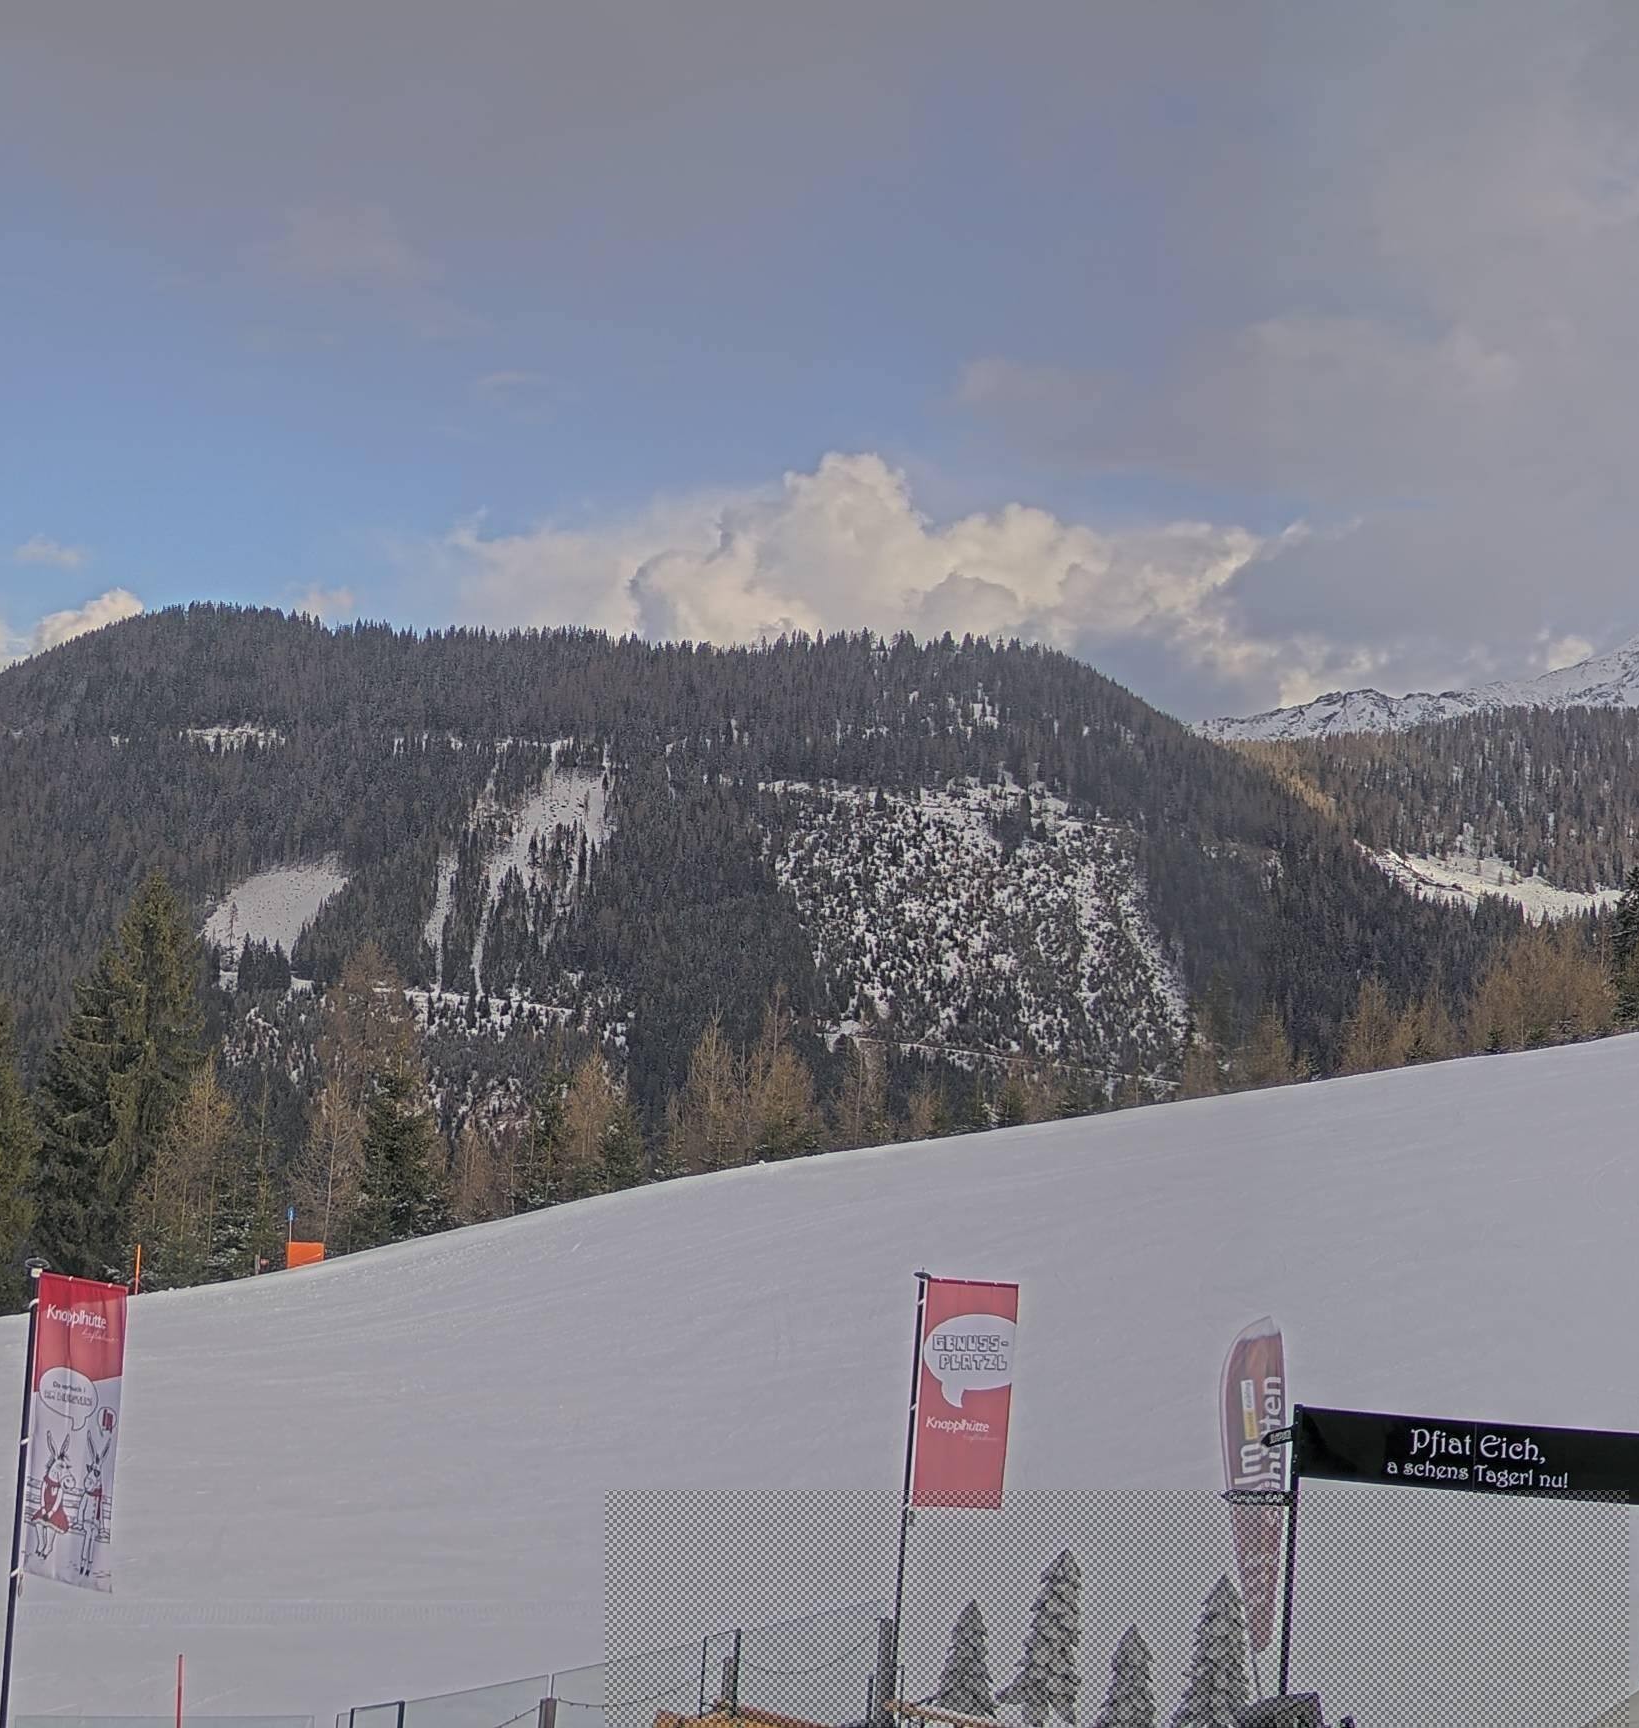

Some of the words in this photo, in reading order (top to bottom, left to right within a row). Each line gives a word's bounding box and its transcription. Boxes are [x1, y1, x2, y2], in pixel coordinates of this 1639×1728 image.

[932, 1334, 1010, 1352] GENUSS-
[939, 1353, 1007, 1371] PLATZL
[1410, 1428, 1471, 1458] Pfiat
[1480, 1434, 1546, 1465] Eich,
[1387, 1461, 1398, 1474] a
[1403, 1461, 1470, 1480] schens
[1474, 1464, 1533, 1488] Tagerl
[1539, 1471, 1569, 1488] nu!
